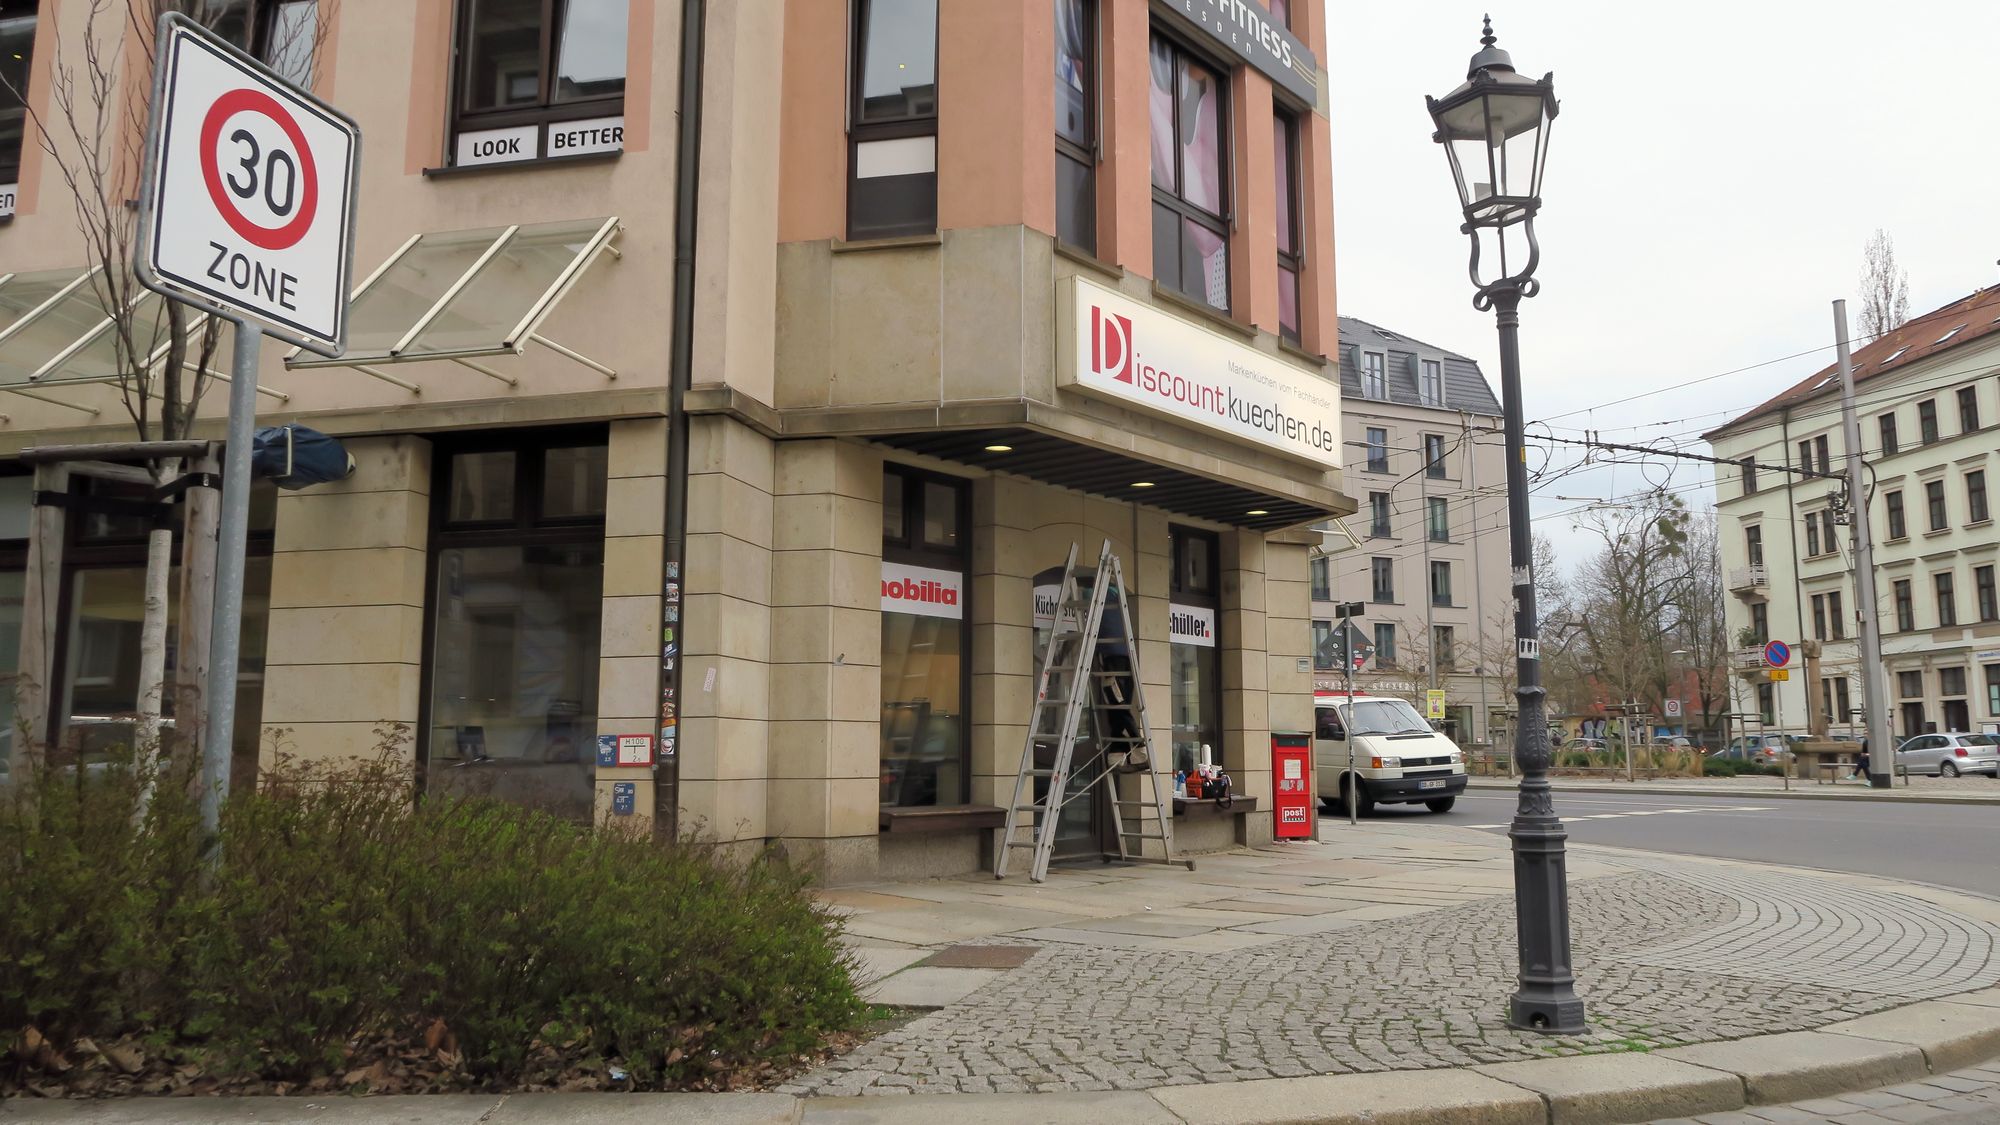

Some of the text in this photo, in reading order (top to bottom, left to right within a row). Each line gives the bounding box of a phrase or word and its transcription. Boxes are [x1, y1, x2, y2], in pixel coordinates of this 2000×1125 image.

[1185, 0, 1252, 54] ESDEN
[473, 127, 624, 158] LOOK BETTER
[226, 128, 296, 217] 30
[206, 240, 298, 312] ZONE
[1169, 612, 1210, 638] hüller.
[1284, 808, 1304, 819] post
